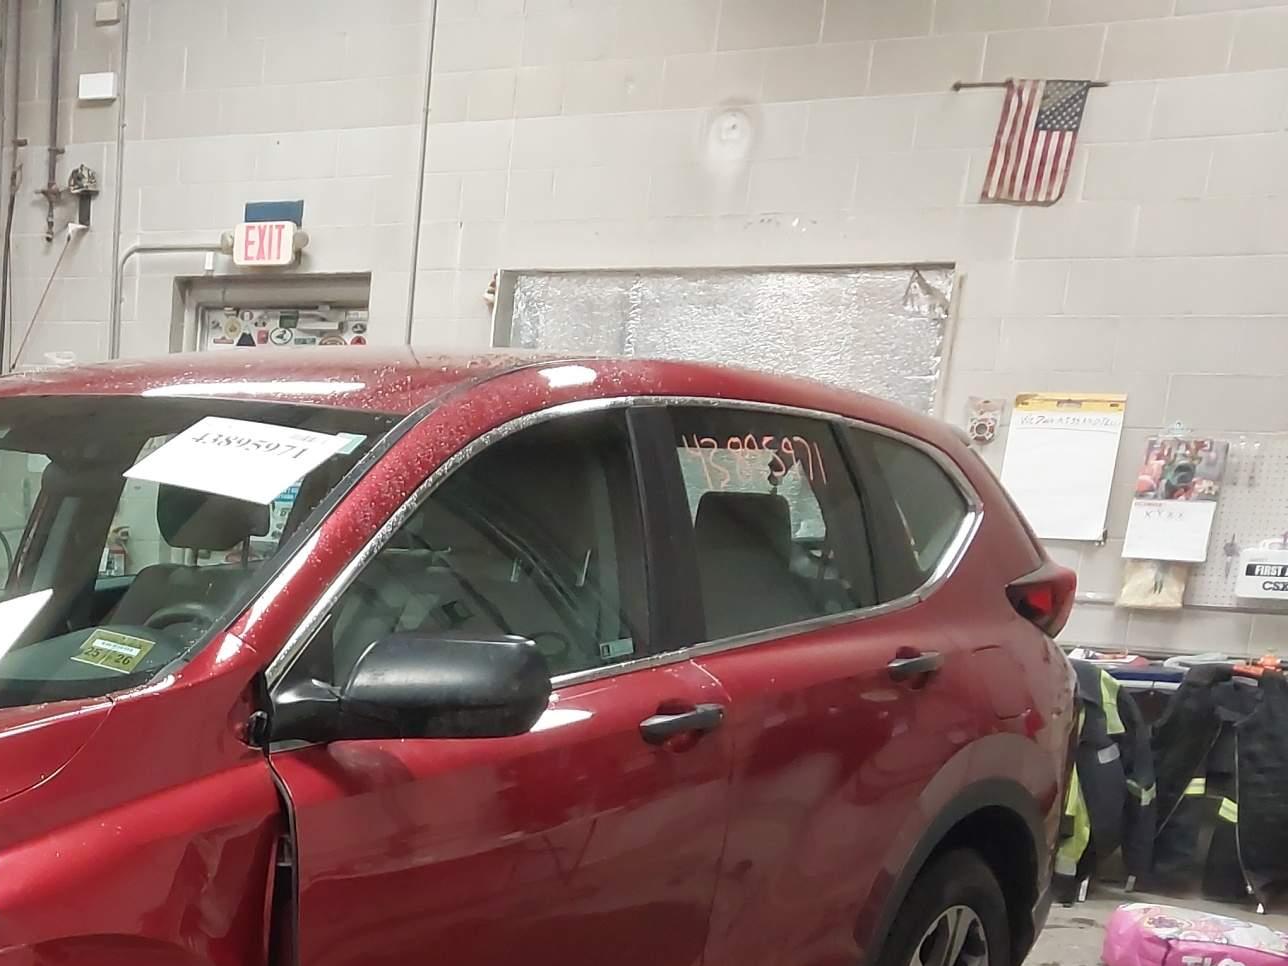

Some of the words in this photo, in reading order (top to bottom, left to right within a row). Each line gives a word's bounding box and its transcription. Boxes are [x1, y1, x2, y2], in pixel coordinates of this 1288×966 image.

[244, 225, 286, 261] EXIT
[192, 432, 309, 459] 43895971
[1255, 564, 1283, 577] FIRST
[114, 653, 132, 666] 26
